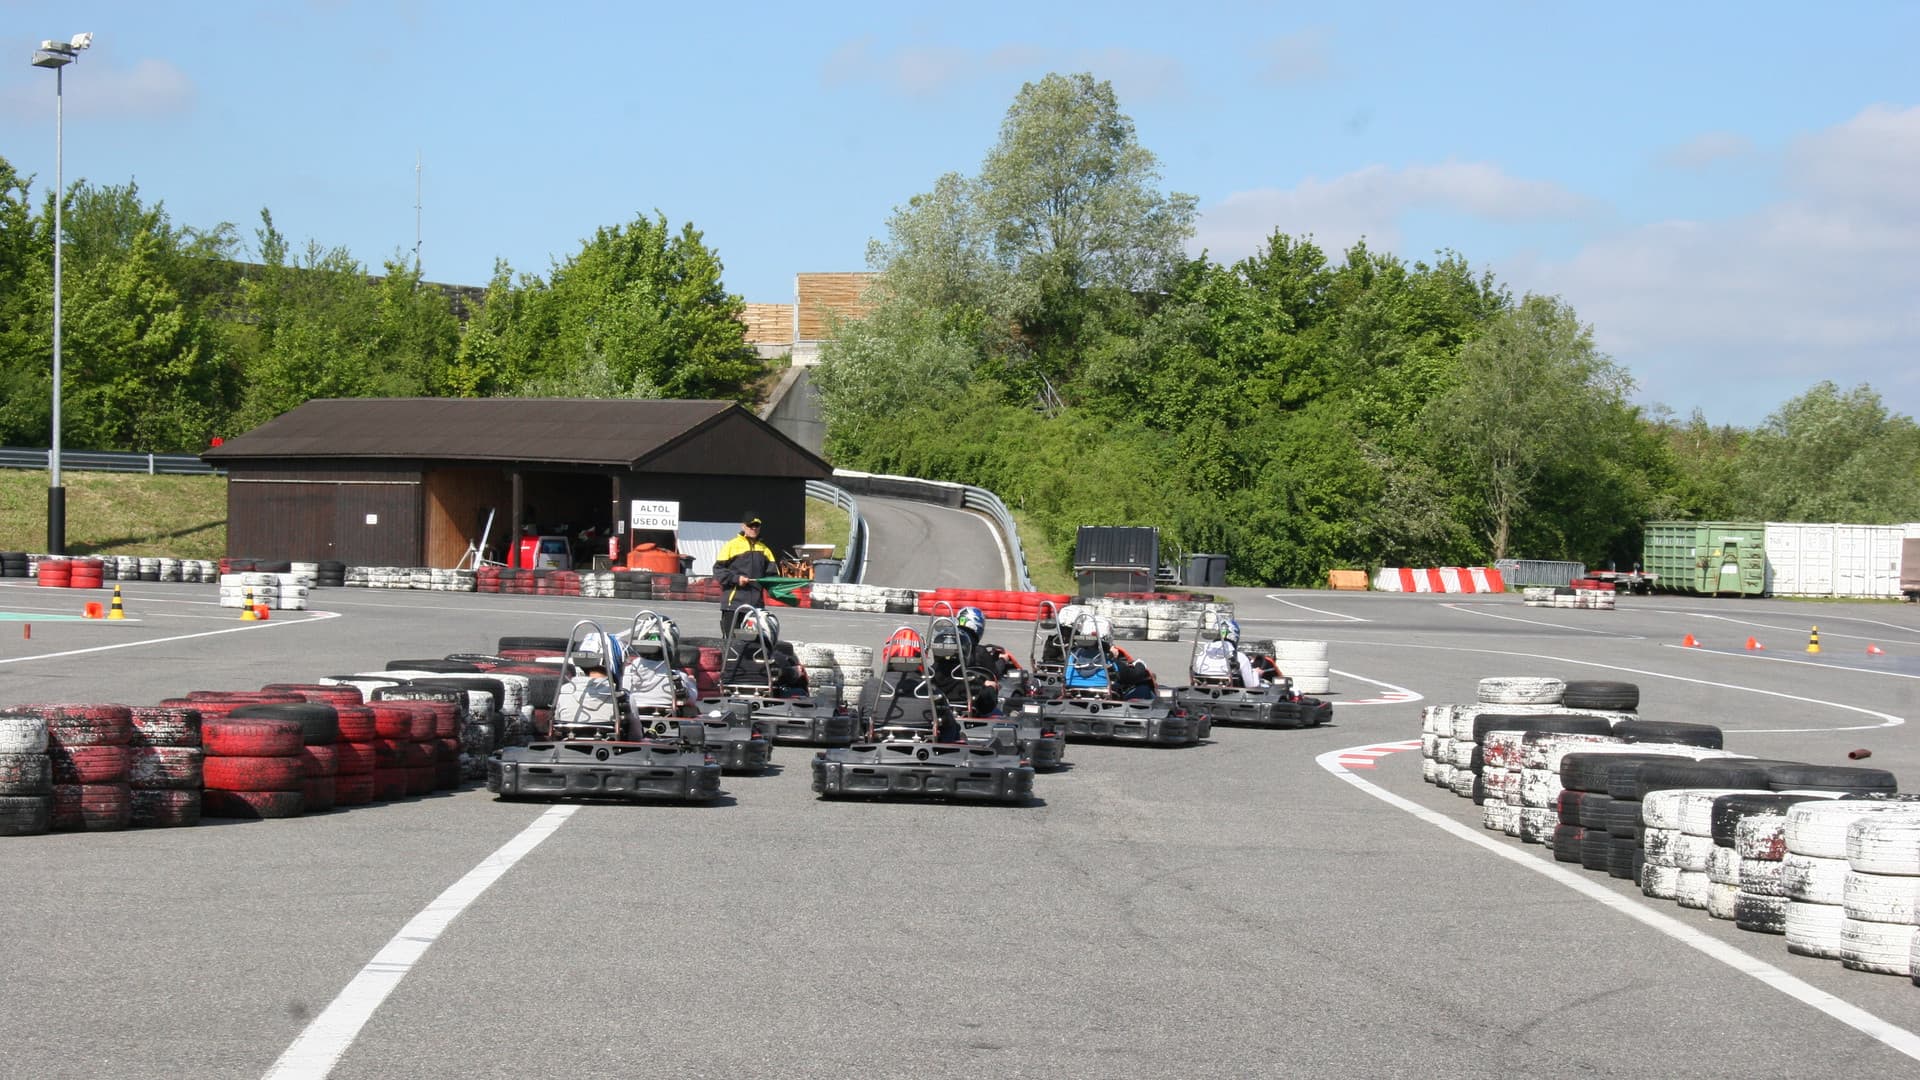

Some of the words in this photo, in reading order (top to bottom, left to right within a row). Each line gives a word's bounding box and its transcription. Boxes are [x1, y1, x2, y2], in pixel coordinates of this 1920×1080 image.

[640, 505, 670, 513] ALTOL
[633, 518, 658, 526] USED
[661, 518, 677, 526] OIL
